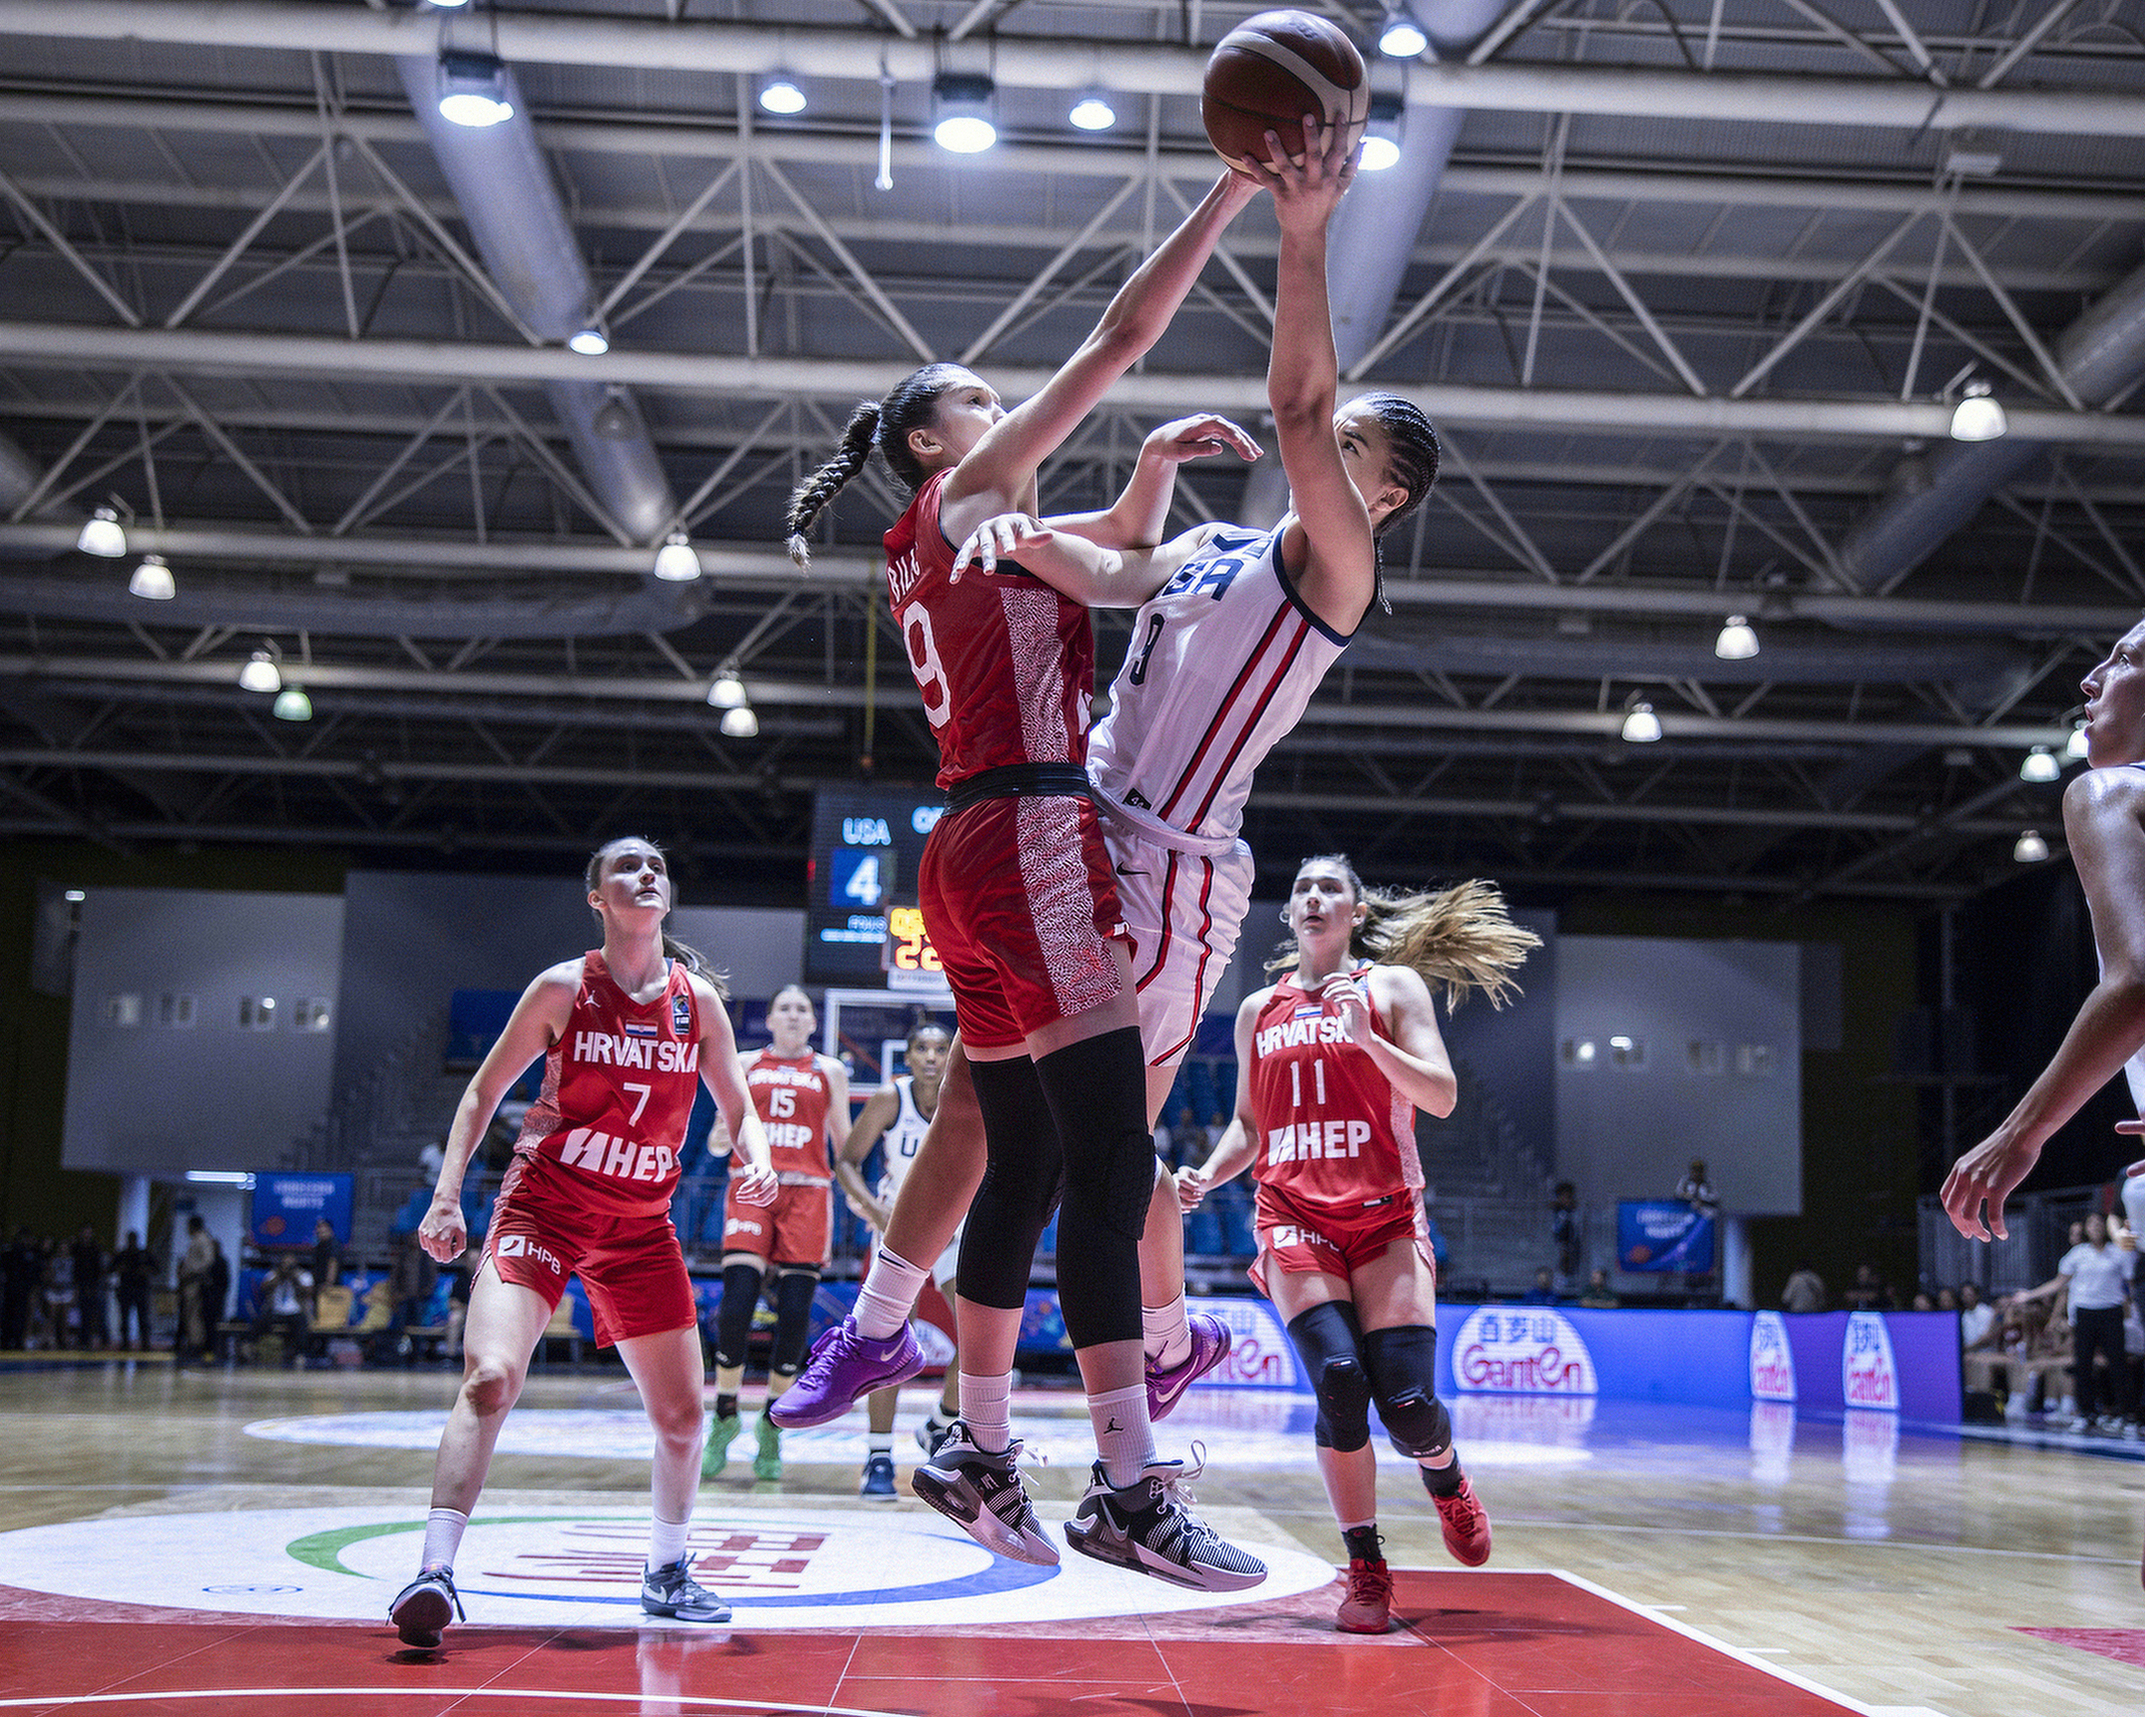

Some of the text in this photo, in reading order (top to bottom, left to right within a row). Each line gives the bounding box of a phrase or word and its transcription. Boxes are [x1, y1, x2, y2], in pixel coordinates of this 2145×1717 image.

[1161, 558, 1245, 602] SA
[903, 600, 951, 729] 9
[1129, 612, 1166, 686] 9
[845, 855, 882, 906] 4
[573, 1031, 699, 1073] HRVATSKA
[1256, 1016, 1354, 1059] HRVATSK
[623, 1082, 651, 1128] 7
[769, 1087, 797, 1118] 15
[1290, 1059, 1326, 1107] 11
[772, 1123, 813, 1149] HEP
[1297, 1120, 1371, 1160] HEP
[603, 1136, 674, 1182] HEP
[527, 1241, 561, 1275] HPB
